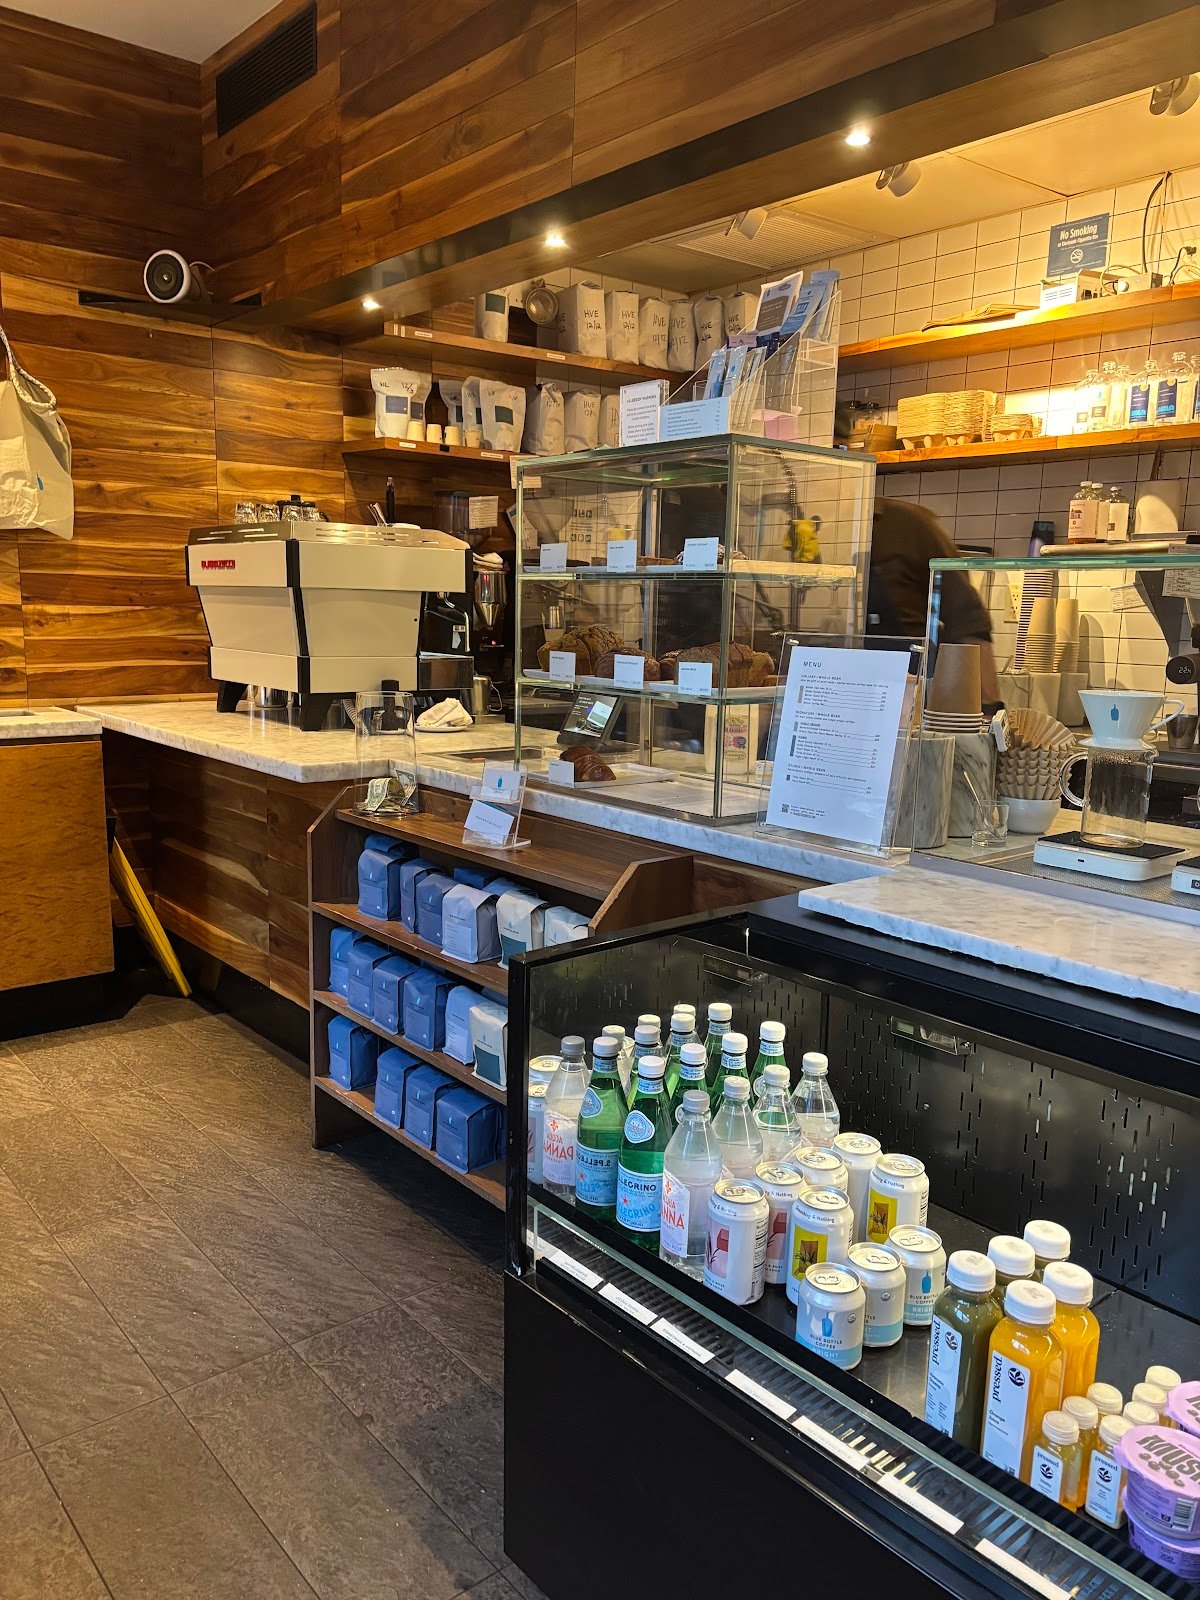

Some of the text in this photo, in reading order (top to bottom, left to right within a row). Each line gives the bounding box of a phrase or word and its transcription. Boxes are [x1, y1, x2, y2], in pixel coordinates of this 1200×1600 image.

[1060, 225, 1098, 241] No Smoking
[584, 309, 599, 318] HVE
[621, 310, 636, 319] HVE
[810, 1333, 822, 1341] BLUE
[1095, 1456, 1118, 1471] pressed
